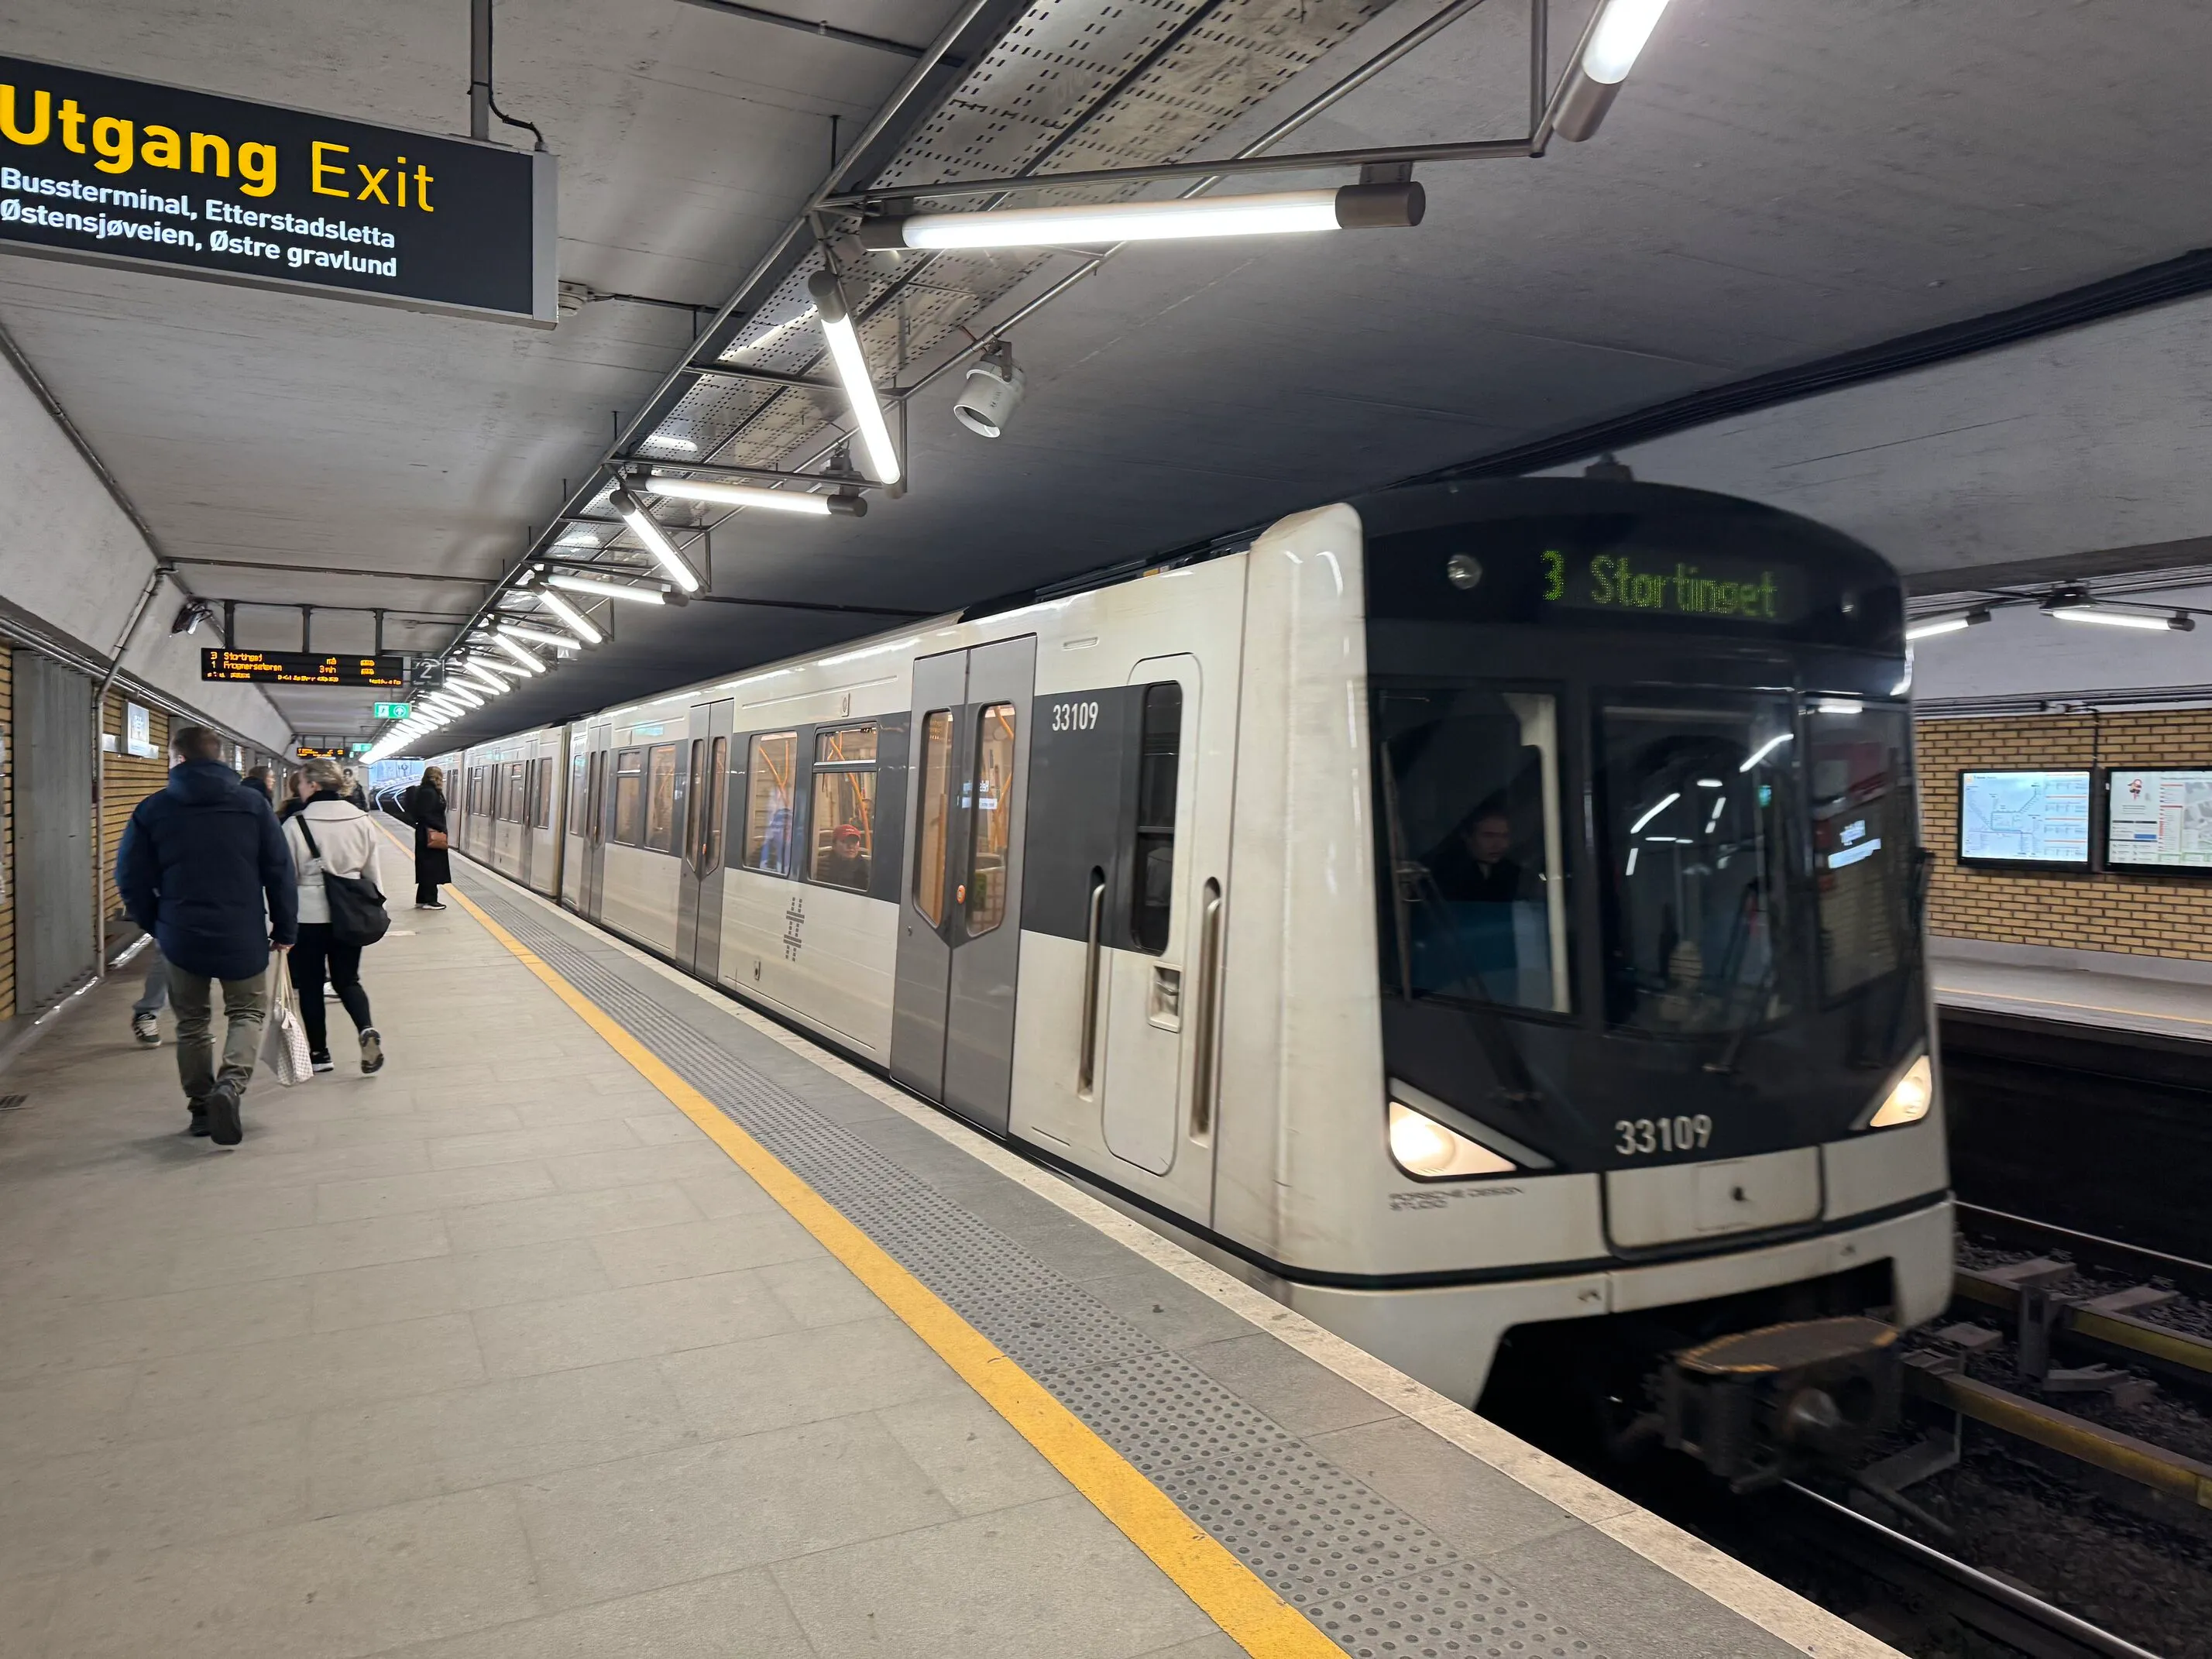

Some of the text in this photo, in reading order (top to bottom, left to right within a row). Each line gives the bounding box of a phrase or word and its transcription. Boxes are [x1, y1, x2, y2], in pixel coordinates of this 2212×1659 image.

[0, 84, 434, 211] Utgang Exit
[1, 167, 396, 249] Bussterminal, Etterstadsletta
[0, 198, 397, 277] Østensjøveien, Østre gravlund
[1540, 549, 1565, 602] 3
[210, 651, 218, 660] 3
[420, 661, 432, 679] 2
[1052, 702, 1099, 731] 33109
[1616, 1114, 1712, 1156] 33109
